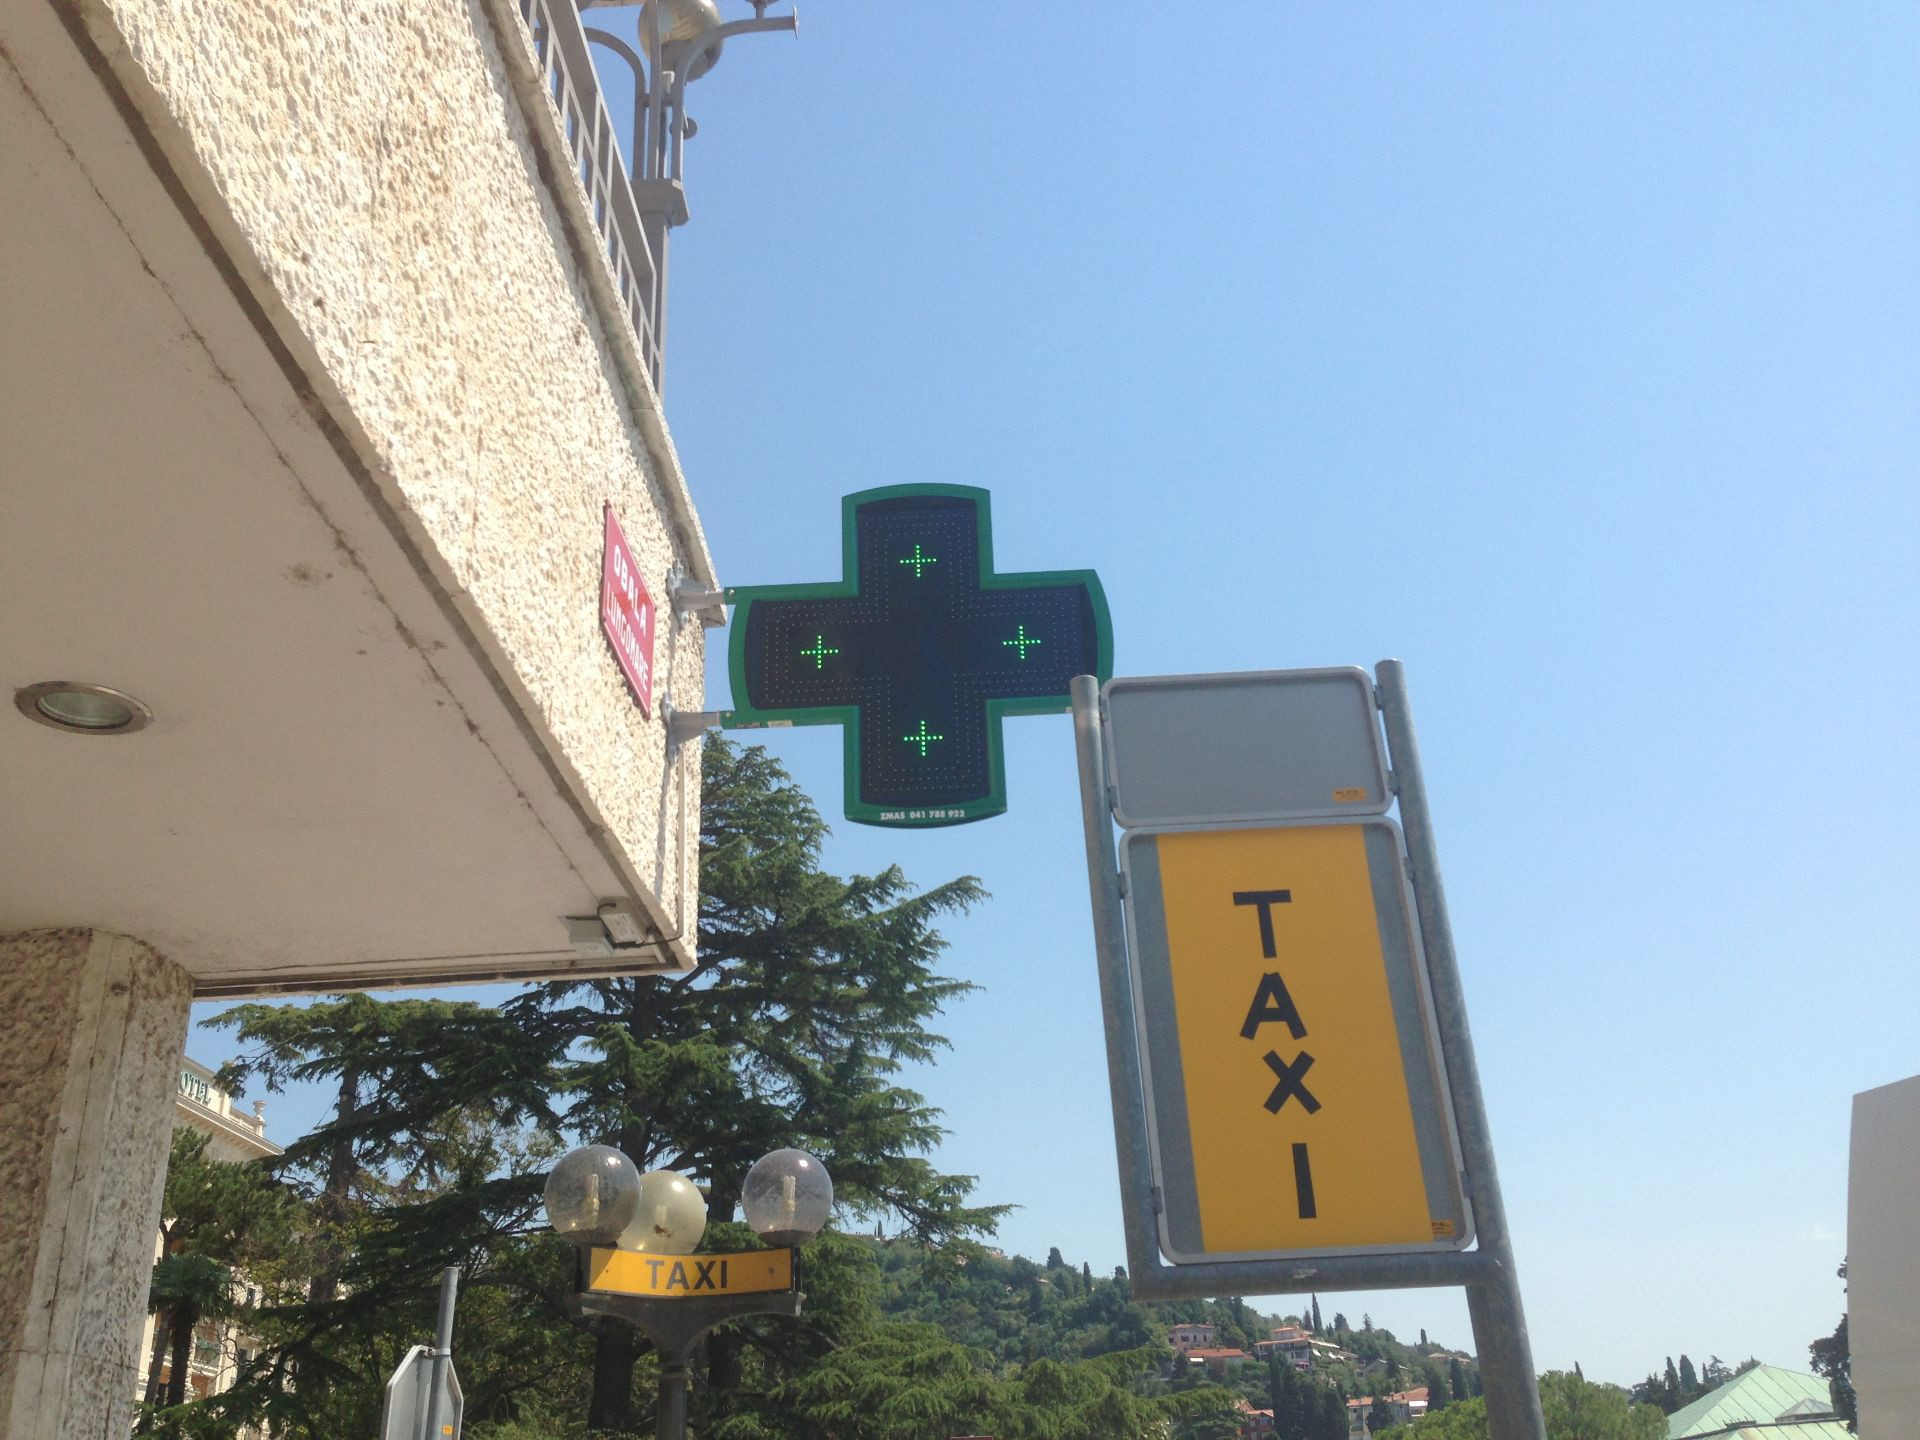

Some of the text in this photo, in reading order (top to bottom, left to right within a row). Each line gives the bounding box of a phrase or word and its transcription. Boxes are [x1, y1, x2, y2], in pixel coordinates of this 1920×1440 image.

[613, 544, 647, 637] OBALA
[606, 582, 649, 693] LUNGOMARE
[909, 810, 926, 819] 041
[1232, 889, 1322, 1219] TAXI
[180, 1071, 212, 1106] OTEL
[645, 1259, 728, 1290] TAXI
